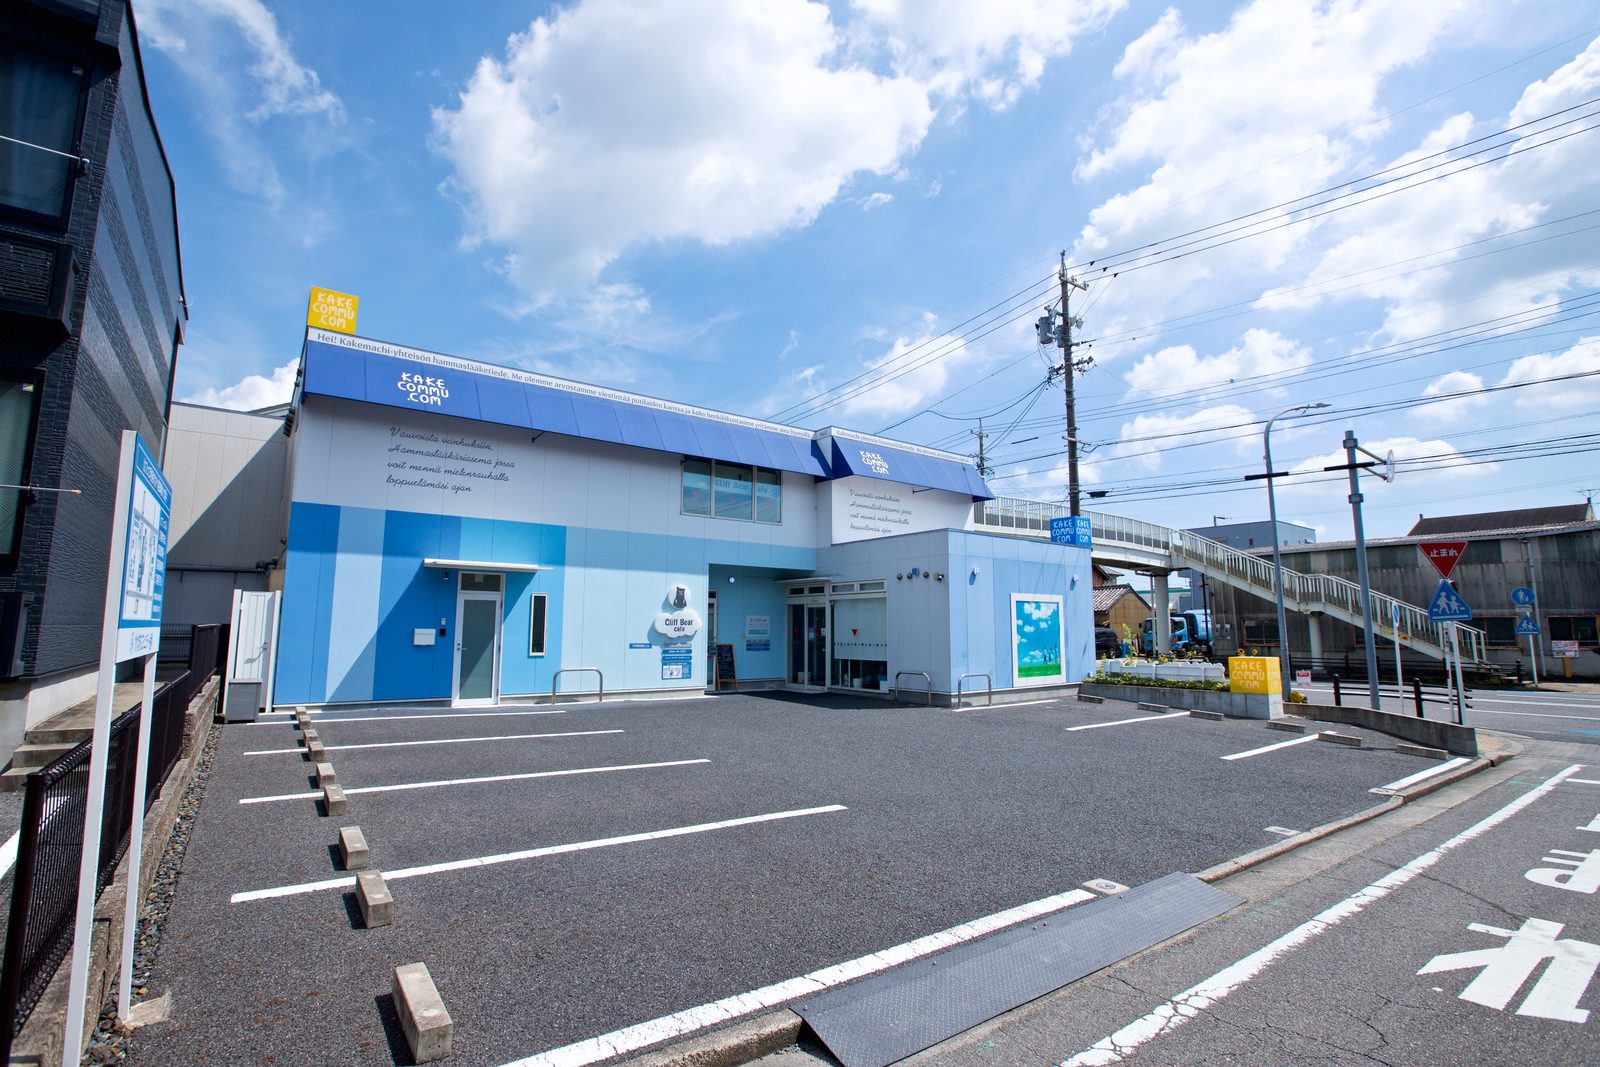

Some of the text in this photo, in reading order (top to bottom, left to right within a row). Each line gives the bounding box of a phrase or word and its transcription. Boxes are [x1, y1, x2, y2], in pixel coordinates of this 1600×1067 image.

[317, 291, 353, 310] KAKE
[312, 302, 355, 320] COMMU
[317, 333, 337, 344] Hei!
[339, 337, 431, 363] Kakemachi-yhteisön
[511, 373, 524, 381] Me
[524, 375, 553, 387] olemme
[554, 382, 597, 396] arvostamme
[631, 396, 663, 409] potilaiden
[691, 408, 706, 418] koko
[401, 372, 445, 389] KAKE
[397, 381, 449, 398] COMMU
[407, 392, 442, 406] .COM
[387, 461, 407, 470] voit
[408, 464, 442, 474] mennä
[493, 458, 516, 469] jossa
[451, 484, 473, 494] ajan
[1053, 519, 1073, 529] KAKE
[1052, 527, 1075, 537] COMMU
[1429, 548, 1459, 558] 止まれ
[664, 618, 694, 626] Cliff Bear
[1233, 661, 1263, 672] KAKE
[1231, 670, 1266, 681] COMMU
